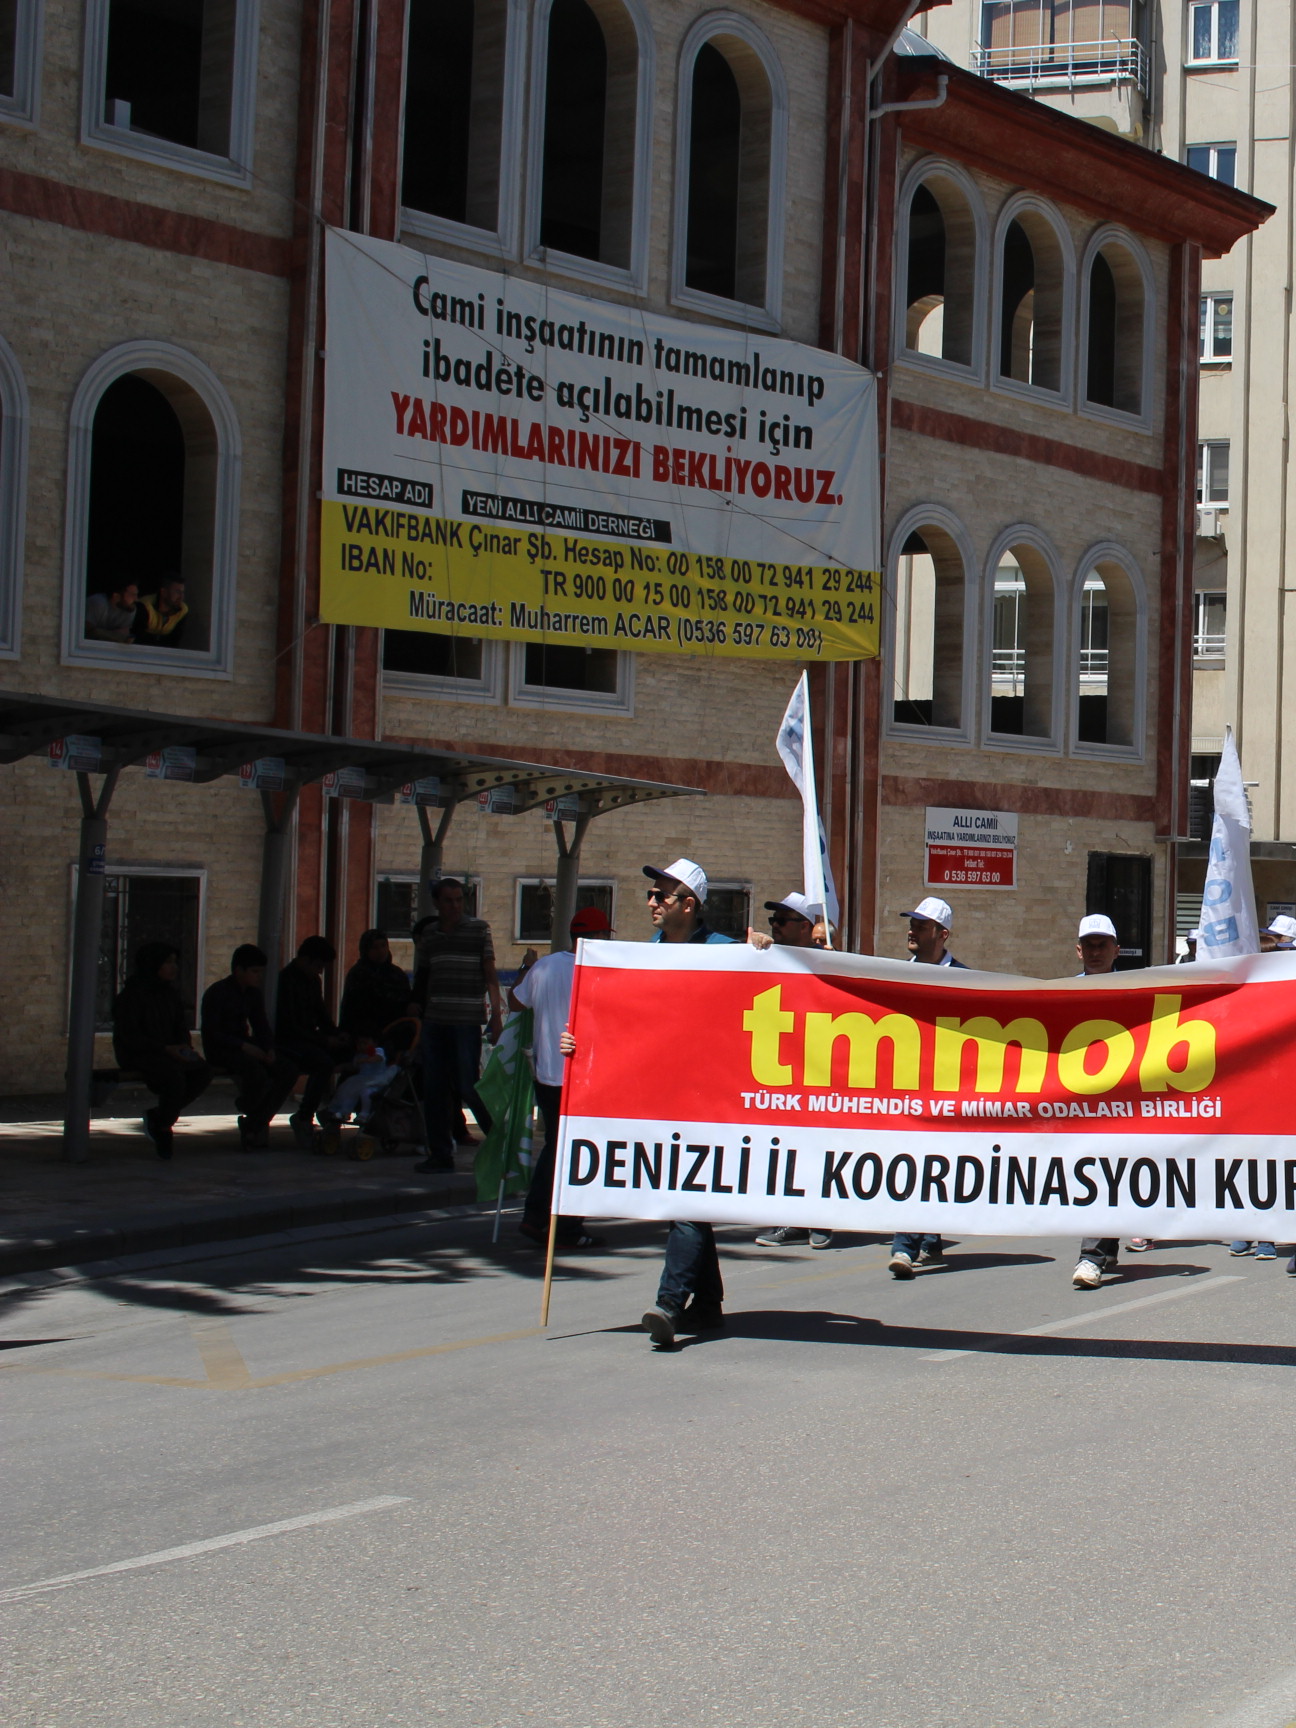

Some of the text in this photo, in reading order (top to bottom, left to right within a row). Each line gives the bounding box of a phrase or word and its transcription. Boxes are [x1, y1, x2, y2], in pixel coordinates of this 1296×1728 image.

[413, 275, 825, 407] Cami inşaatının tamamlanıp
[422, 337, 813, 457] ibadete açılabilmesi için
[390, 391, 843, 506] YARDIMLARINIZI BEKLİYORUZ.
[343, 473, 429, 505] HESAP ADI
[467, 494, 655, 539] YENİ ALLI CAMİİ DERNEĞİ
[341, 543, 433, 581] IBAN No:
[342, 504, 873, 594] VAKIFBANK Çınar Şb. Hesap No: 00 158 00 72 941 29 244
[409, 590, 503, 626] Müracaat:
[510, 602, 609, 634] Muharrem
[613, 612, 672, 641] ACAR
[677, 617, 727, 647] (0536
[732, 621, 765, 645] 597
[769, 625, 790, 648] 63
[540, 570, 874, 625] TR 900 00 15 00 158 00 72 941 29 244
[927, 828, 955, 842] İNŞAATINA
[953, 815, 998, 830] ALLI CAMİİ
[944, 870, 1000, 882] 0 536 597 63 00
[743, 984, 1216, 1095] tmmob
[741, 1091, 1222, 1119] TÜRK MÜHENDİS VE MİMAR ODALARI BİRLİĞİ
[568, 1132, 752, 1195] DENİZLİ
[766, 1137, 805, 1197] İL
[821, 1144, 1196, 1208] KOORDİNASYON
